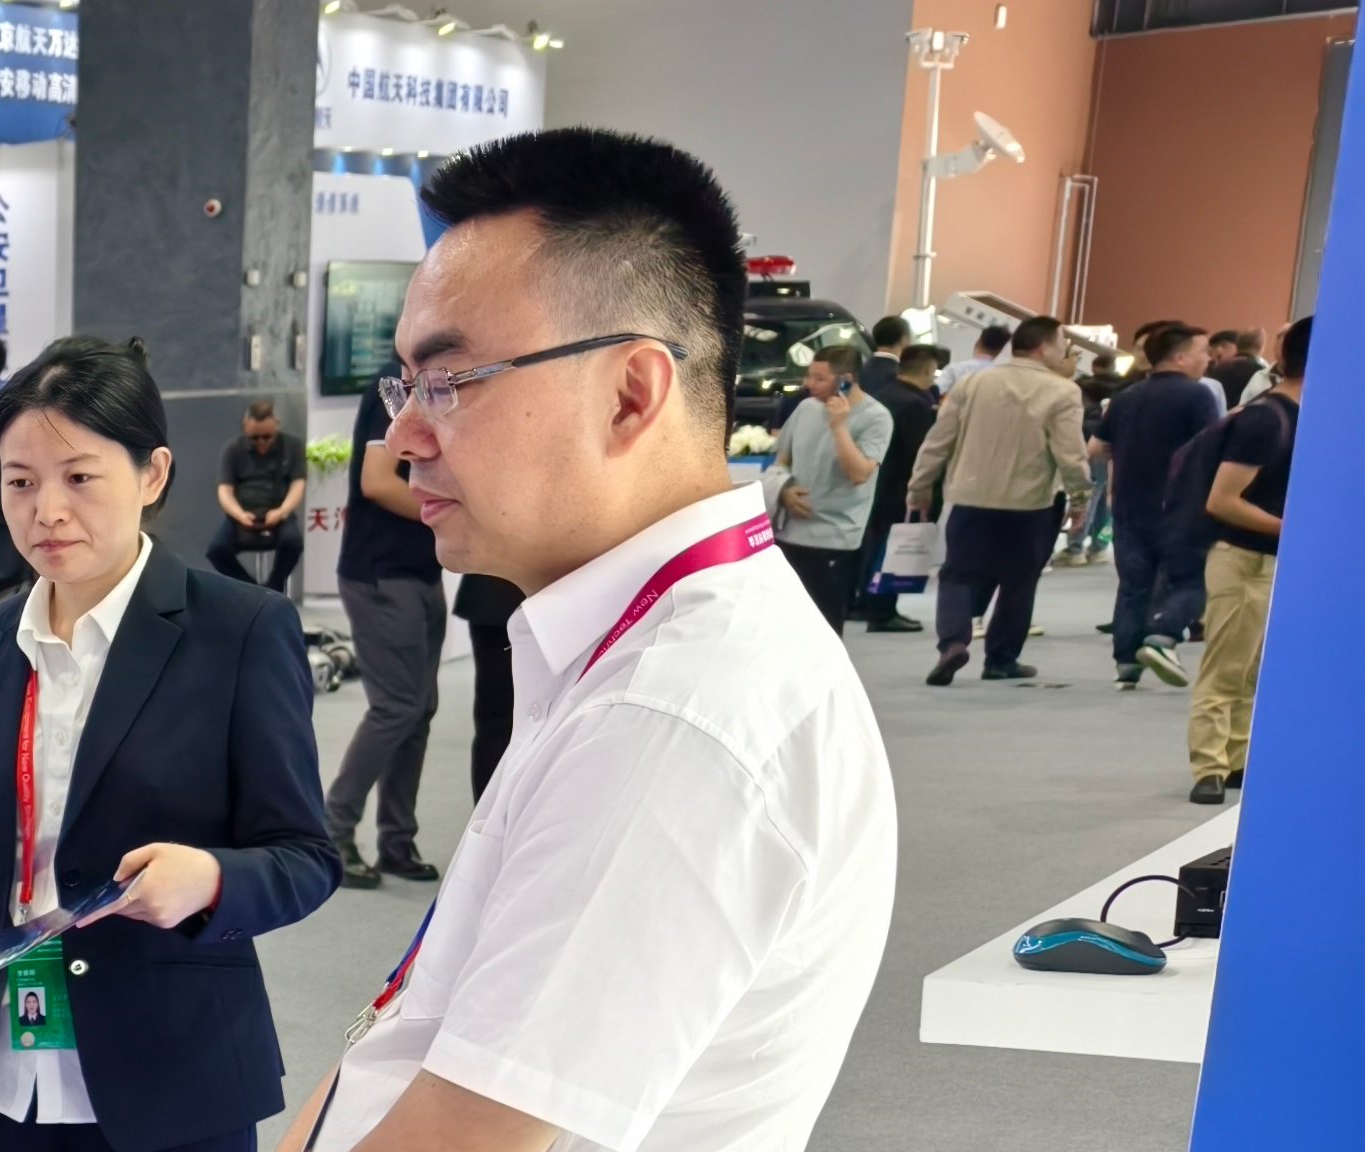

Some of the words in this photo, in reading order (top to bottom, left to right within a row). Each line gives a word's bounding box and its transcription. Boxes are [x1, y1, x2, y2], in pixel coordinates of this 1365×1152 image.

[348, 66, 509, 118] 中国航天科技集团有限公司
